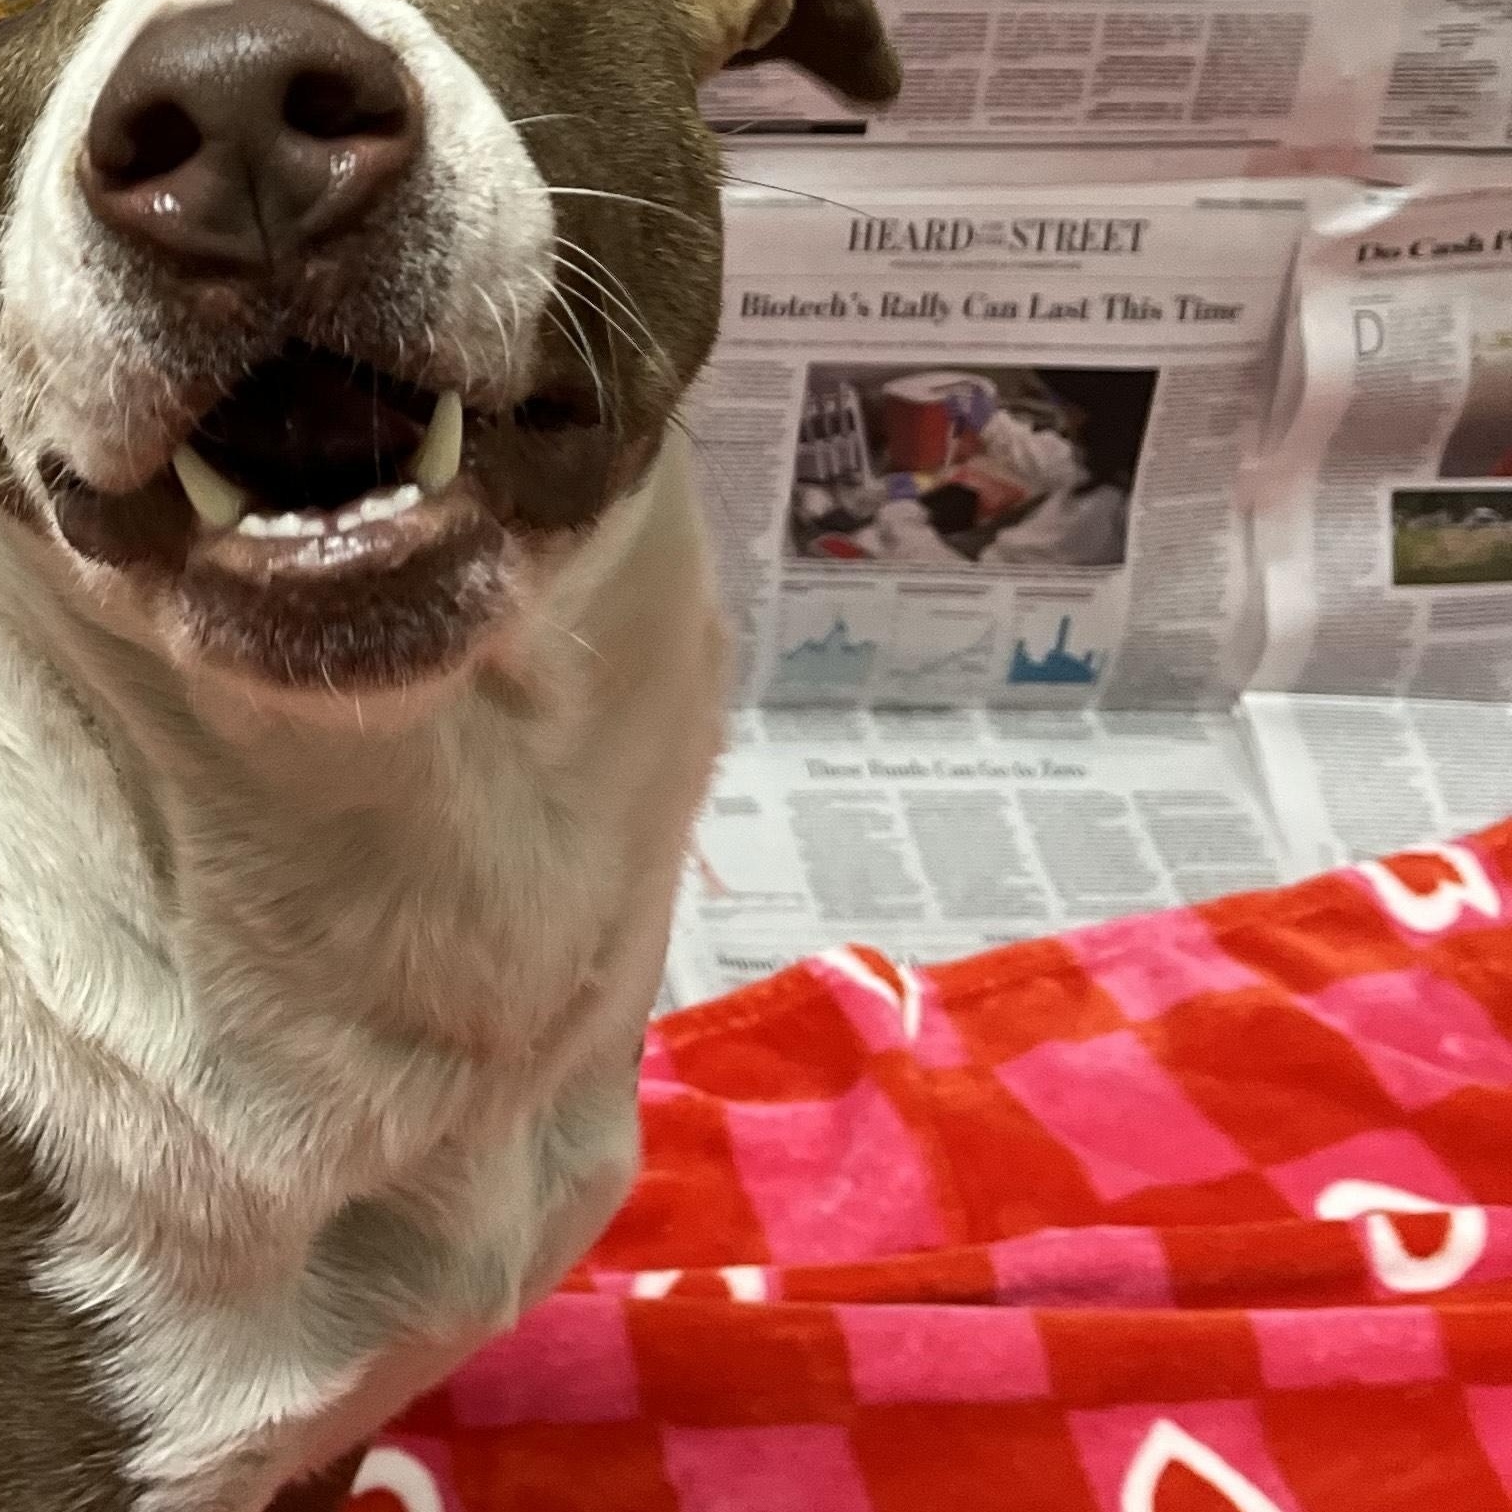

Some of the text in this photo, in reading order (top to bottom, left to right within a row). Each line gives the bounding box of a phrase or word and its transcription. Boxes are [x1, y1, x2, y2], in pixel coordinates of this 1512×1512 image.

[847, 217, 975, 253] HEARD
[1007, 217, 1150, 254] STREET
[880, 292, 950, 325] Rally
[962, 291, 1020, 320] Can
[1029, 291, 1089, 320] Last
[1102, 292, 1163, 322] This
[1175, 293, 1245, 322] Time
